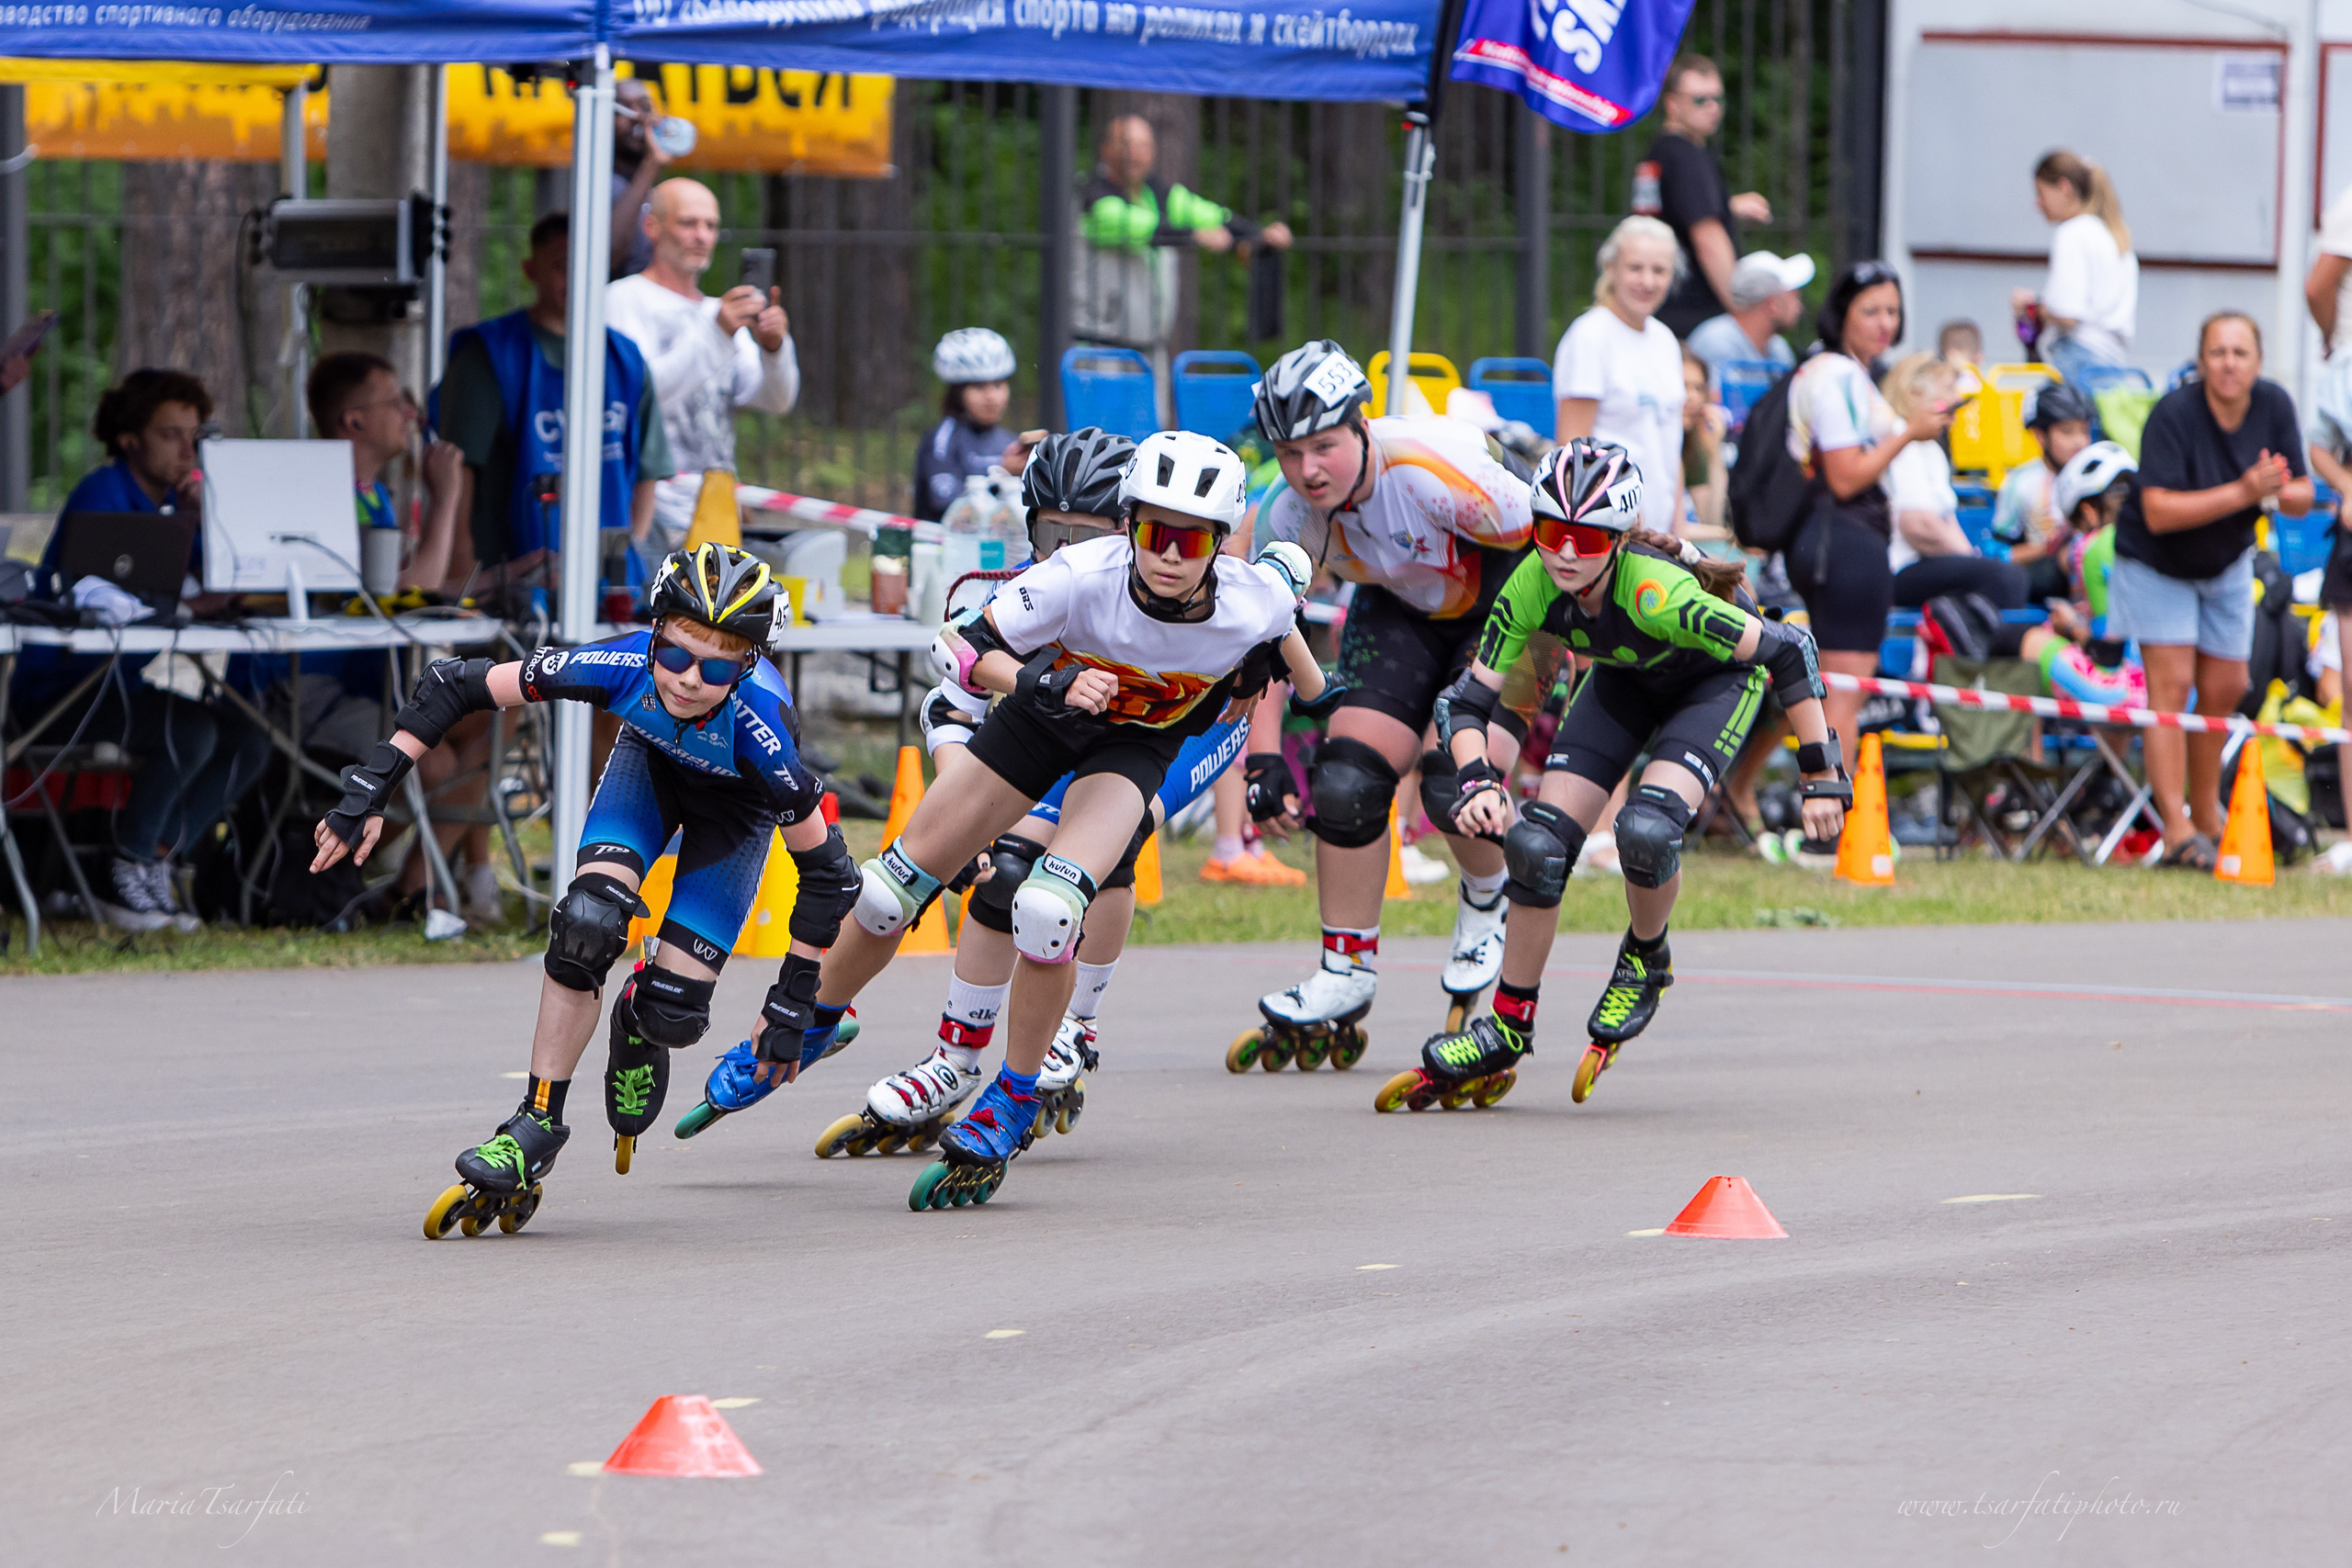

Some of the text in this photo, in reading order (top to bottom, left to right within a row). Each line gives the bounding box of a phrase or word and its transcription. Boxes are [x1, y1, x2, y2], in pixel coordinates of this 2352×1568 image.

[1318, 362, 1352, 395] 553
[569, 649, 649, 668] POWERS
[731, 691, 782, 756] ATTER
[1048, 860, 1078, 880] kufun
